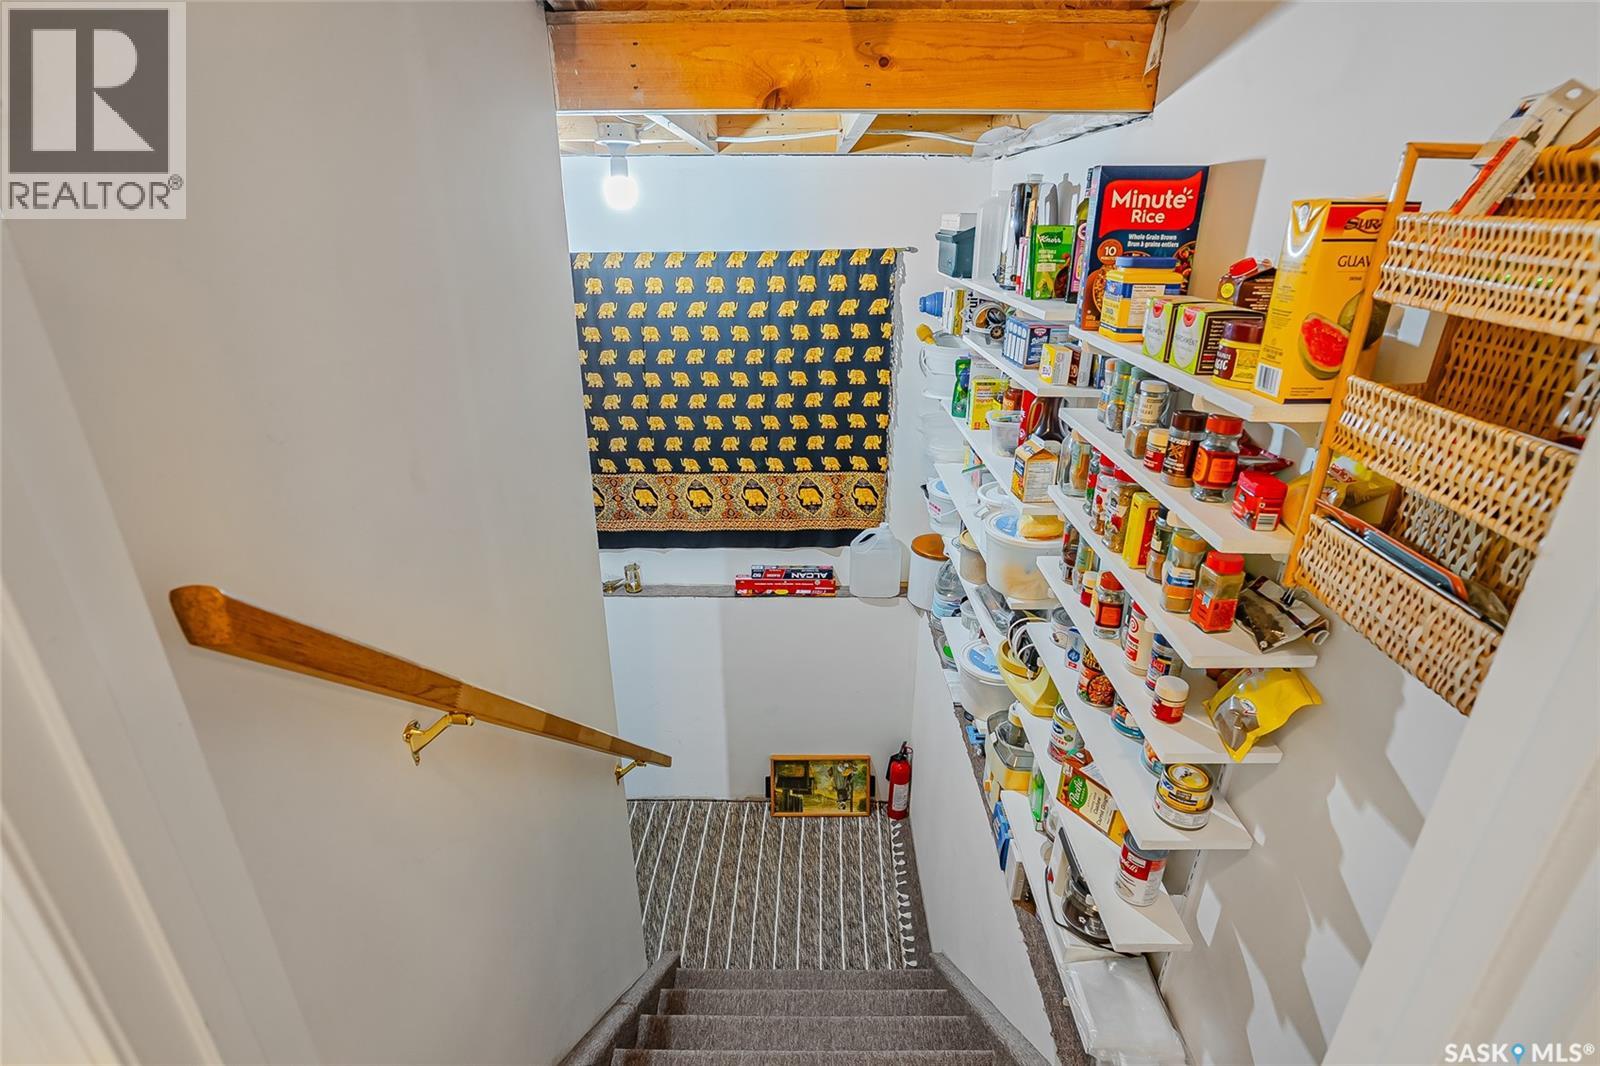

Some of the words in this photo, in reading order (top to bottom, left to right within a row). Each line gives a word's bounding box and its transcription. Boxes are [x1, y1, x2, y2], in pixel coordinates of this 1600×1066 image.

[1111, 188, 1188, 209] Minute
[1131, 209, 1166, 224] Rice
[1037, 234, 1062, 245] Knorr
[1128, 233, 1145, 241] Whole
[1145, 233, 1160, 241] Grain
[1104, 246, 1117, 256] 10
[1068, 777, 1084, 806] Pacific
